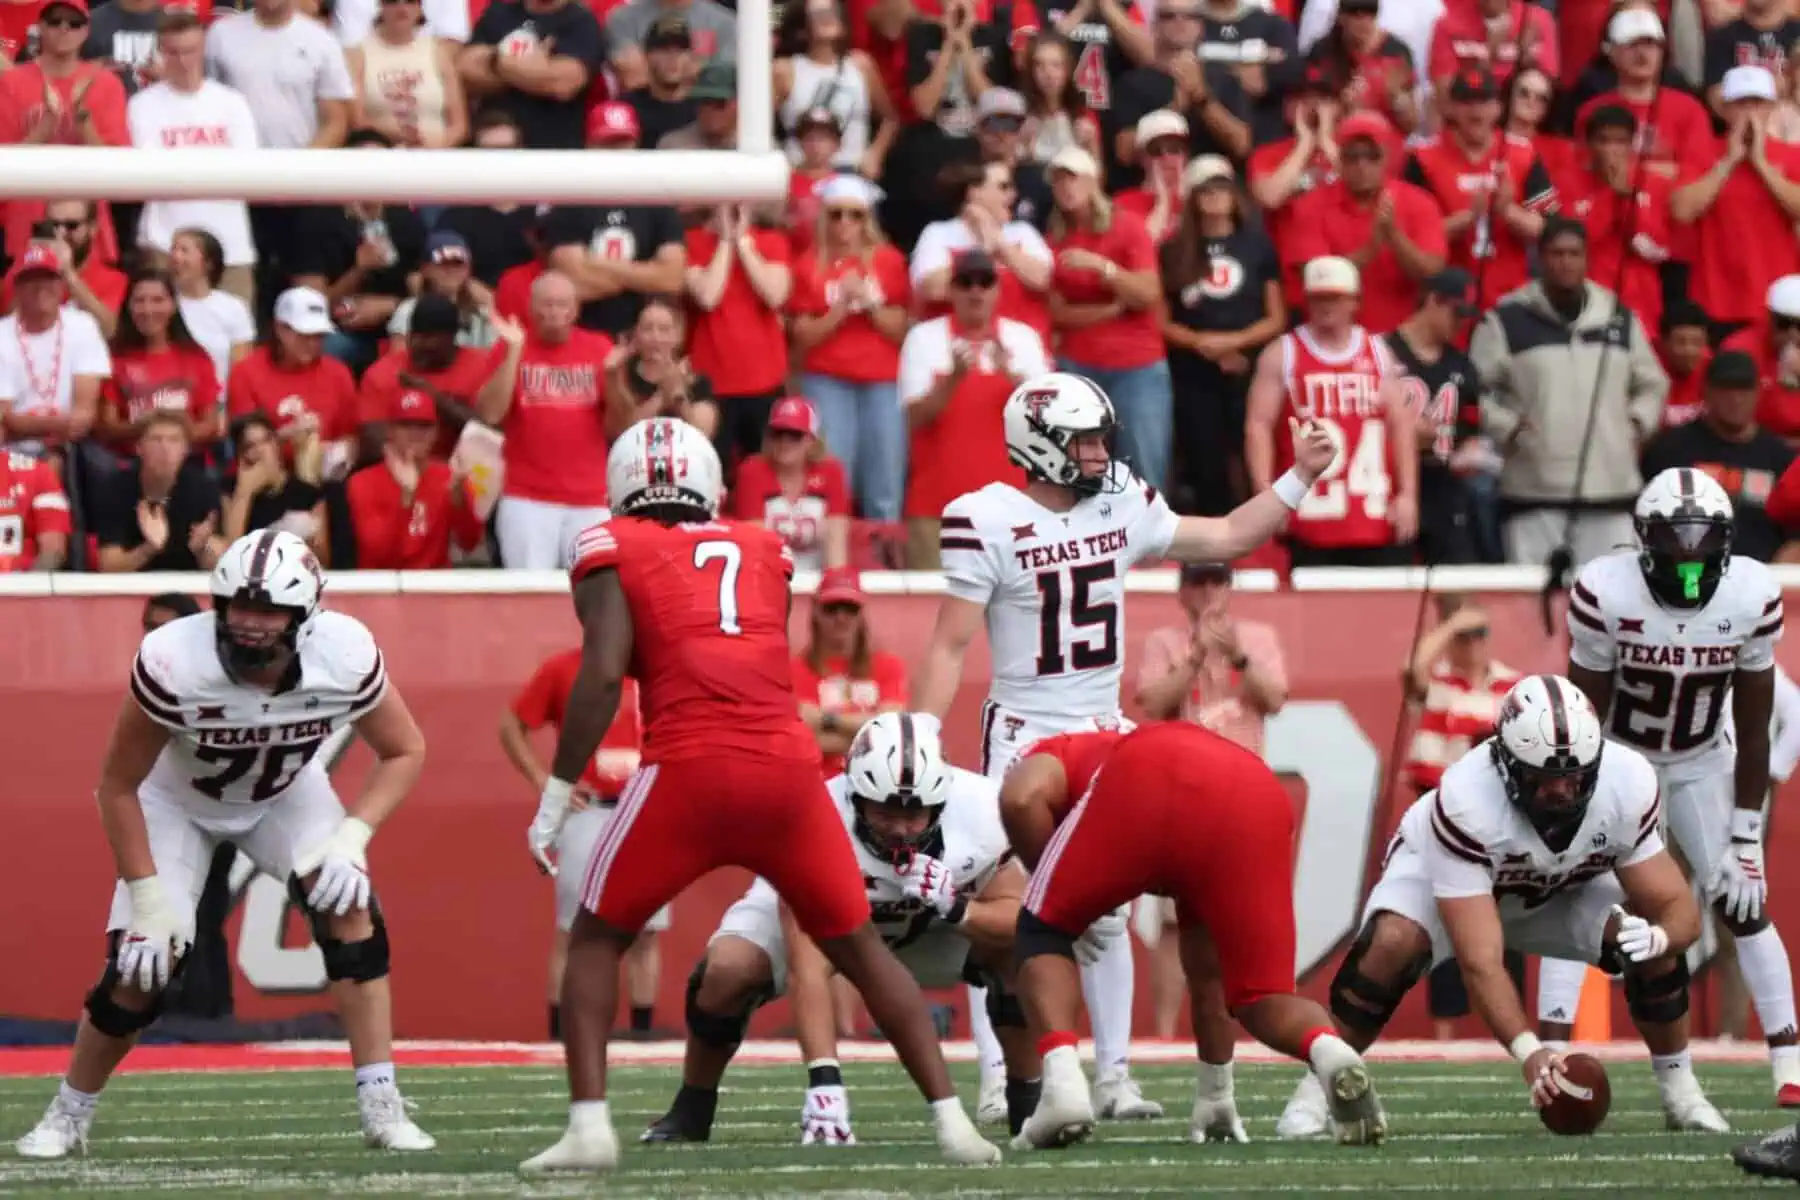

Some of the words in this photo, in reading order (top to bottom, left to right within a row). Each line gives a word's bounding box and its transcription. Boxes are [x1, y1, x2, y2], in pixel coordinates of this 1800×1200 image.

[521, 365, 597, 397] UTAH
[1014, 540, 1081, 571] TEXAS
[1083, 527, 1129, 552] TECH
[694, 540, 743, 634] 7
[1036, 558, 1118, 677] 15
[1615, 640, 1685, 666] TEXAS
[197, 727, 271, 745] TEXAS
[280, 718, 333, 741] TECH
[1611, 665, 1732, 752] 20
[191, 739, 323, 801] 70
